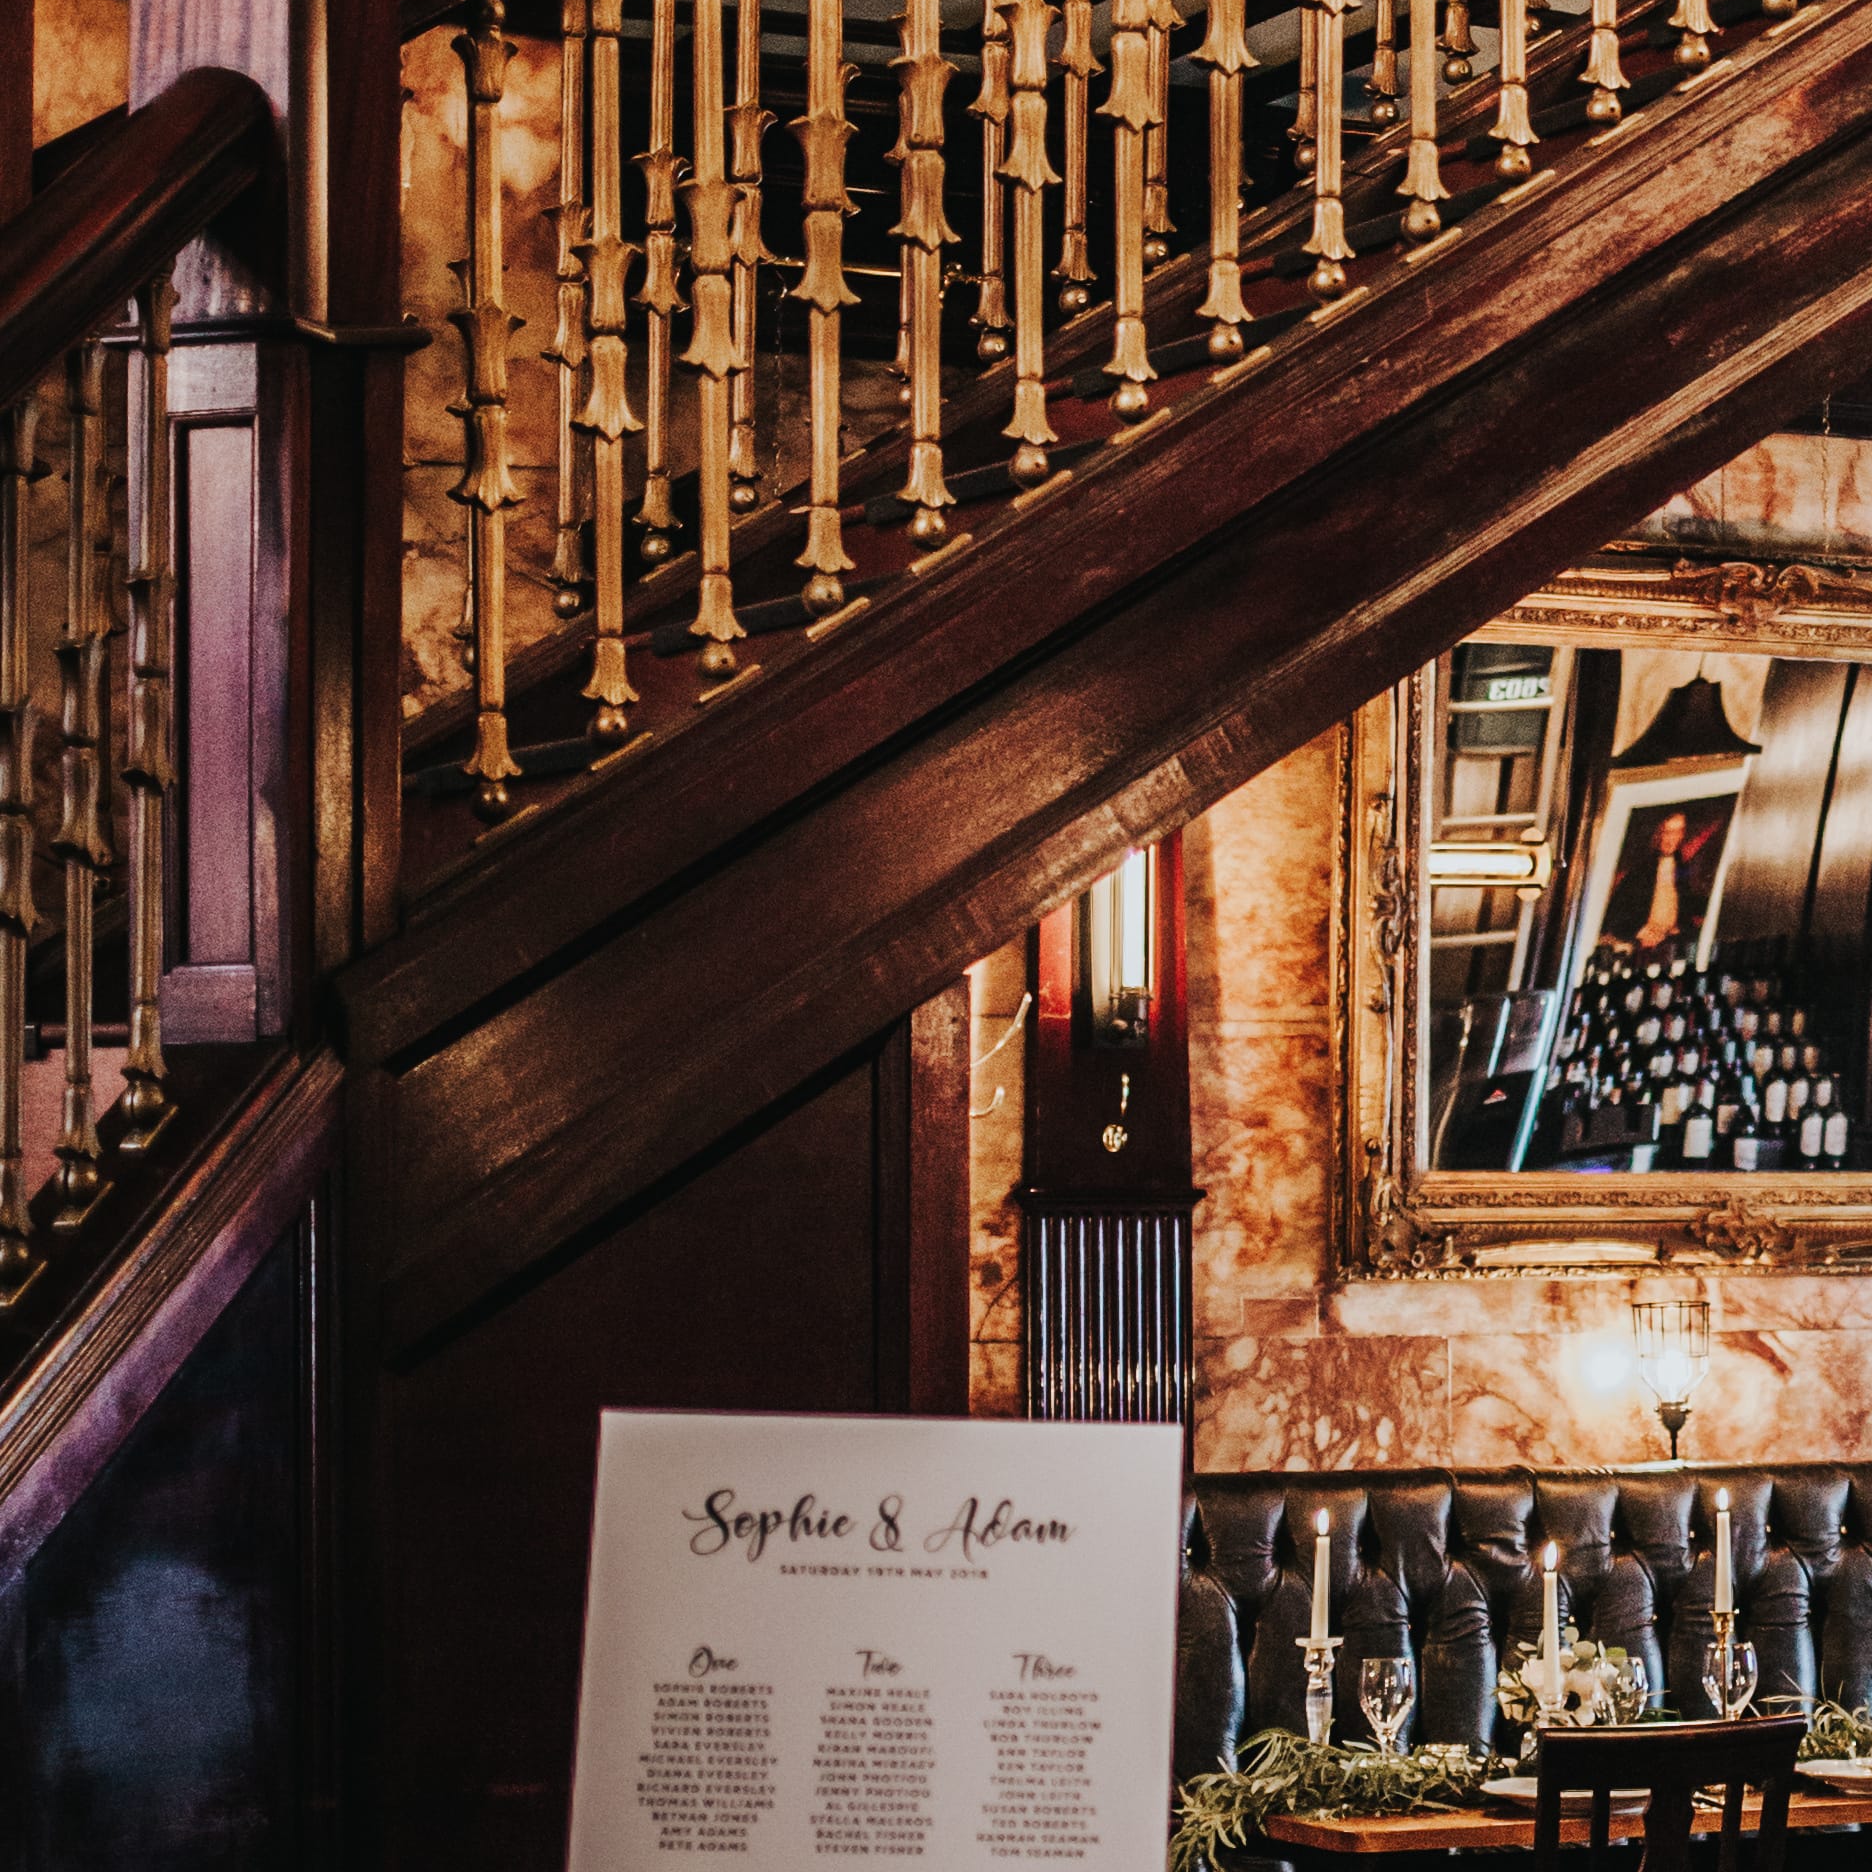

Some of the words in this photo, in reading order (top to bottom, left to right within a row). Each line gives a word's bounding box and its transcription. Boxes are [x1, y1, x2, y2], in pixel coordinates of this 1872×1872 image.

[682, 1489, 855, 1563] Sophie
[870, 1494, 904, 1554] &
[923, 1497, 1077, 1564] Adam
[780, 1564, 860, 1576] SATURDAY
[910, 1567, 944, 1578] MAY
[689, 1646, 739, 1678] One
[855, 1649, 904, 1679] Two
[1012, 1653, 1077, 1682] Three
[709, 1684, 775, 1695] ROBERTS
[703, 1698, 769, 1709] ROBERTS
[705, 1713, 771, 1723] ROBERTS
[706, 1727, 771, 1737] ROBERTS
[697, 1827, 749, 1838] ADAMS
[697, 1841, 749, 1852] ADAMS
